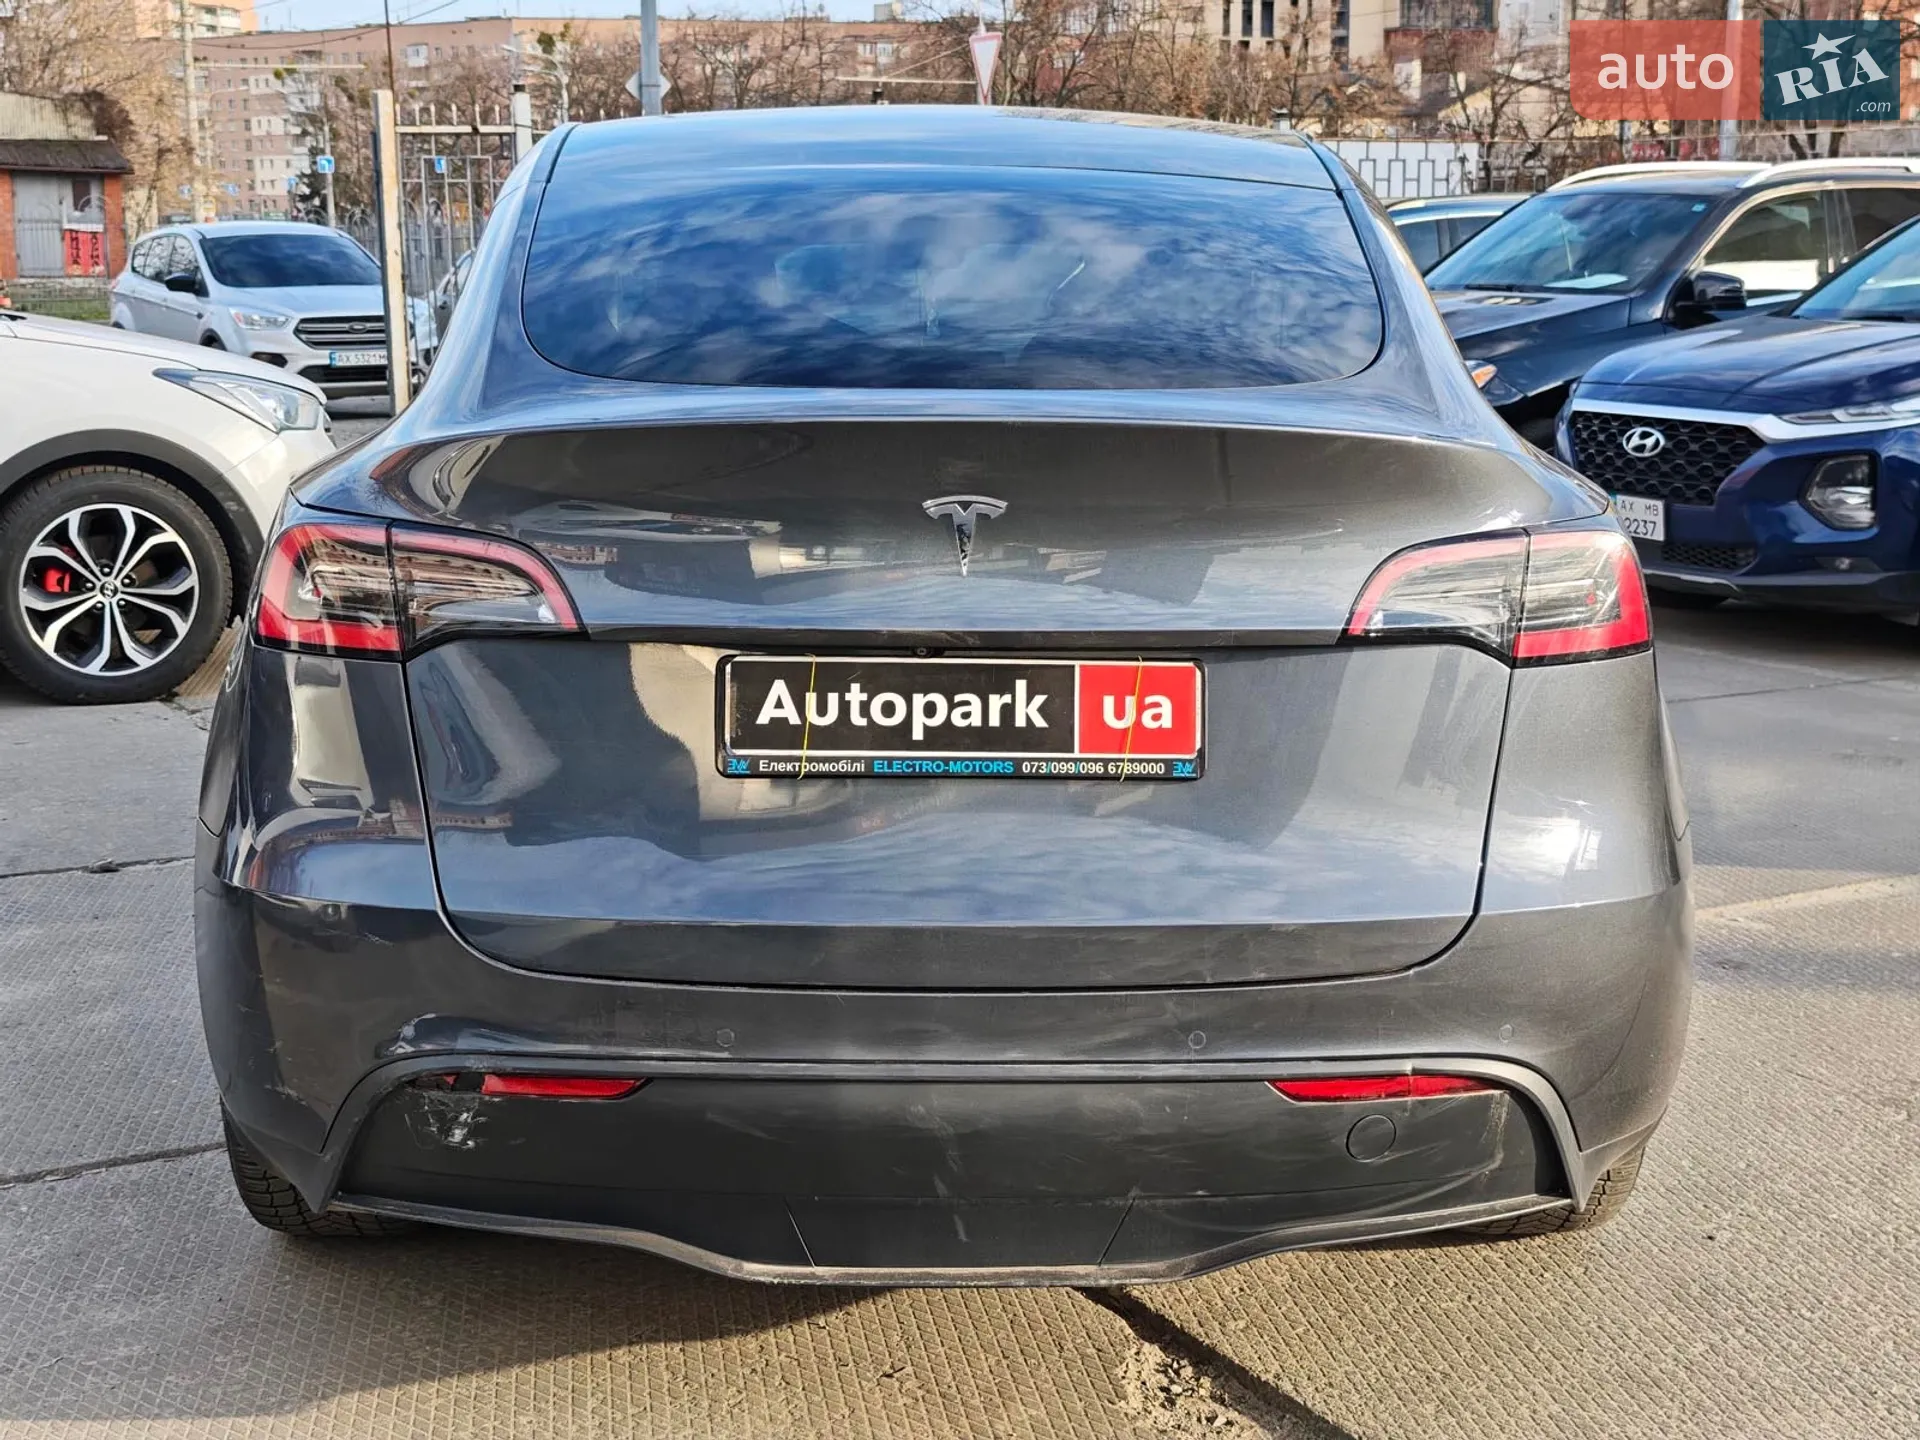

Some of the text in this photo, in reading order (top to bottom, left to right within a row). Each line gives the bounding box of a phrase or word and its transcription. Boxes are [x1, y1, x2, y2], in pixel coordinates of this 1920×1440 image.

[1623, 517, 1657, 537] 2237
[755, 679, 1173, 740] Autopark ua
[758, 759, 866, 774] Електромобілі
[873, 760, 1014, 773] ELECTRO-MOTORS
[1022, 761, 1104, 774] 073/099/096
[1107, 762, 1166, 775] 6789000
